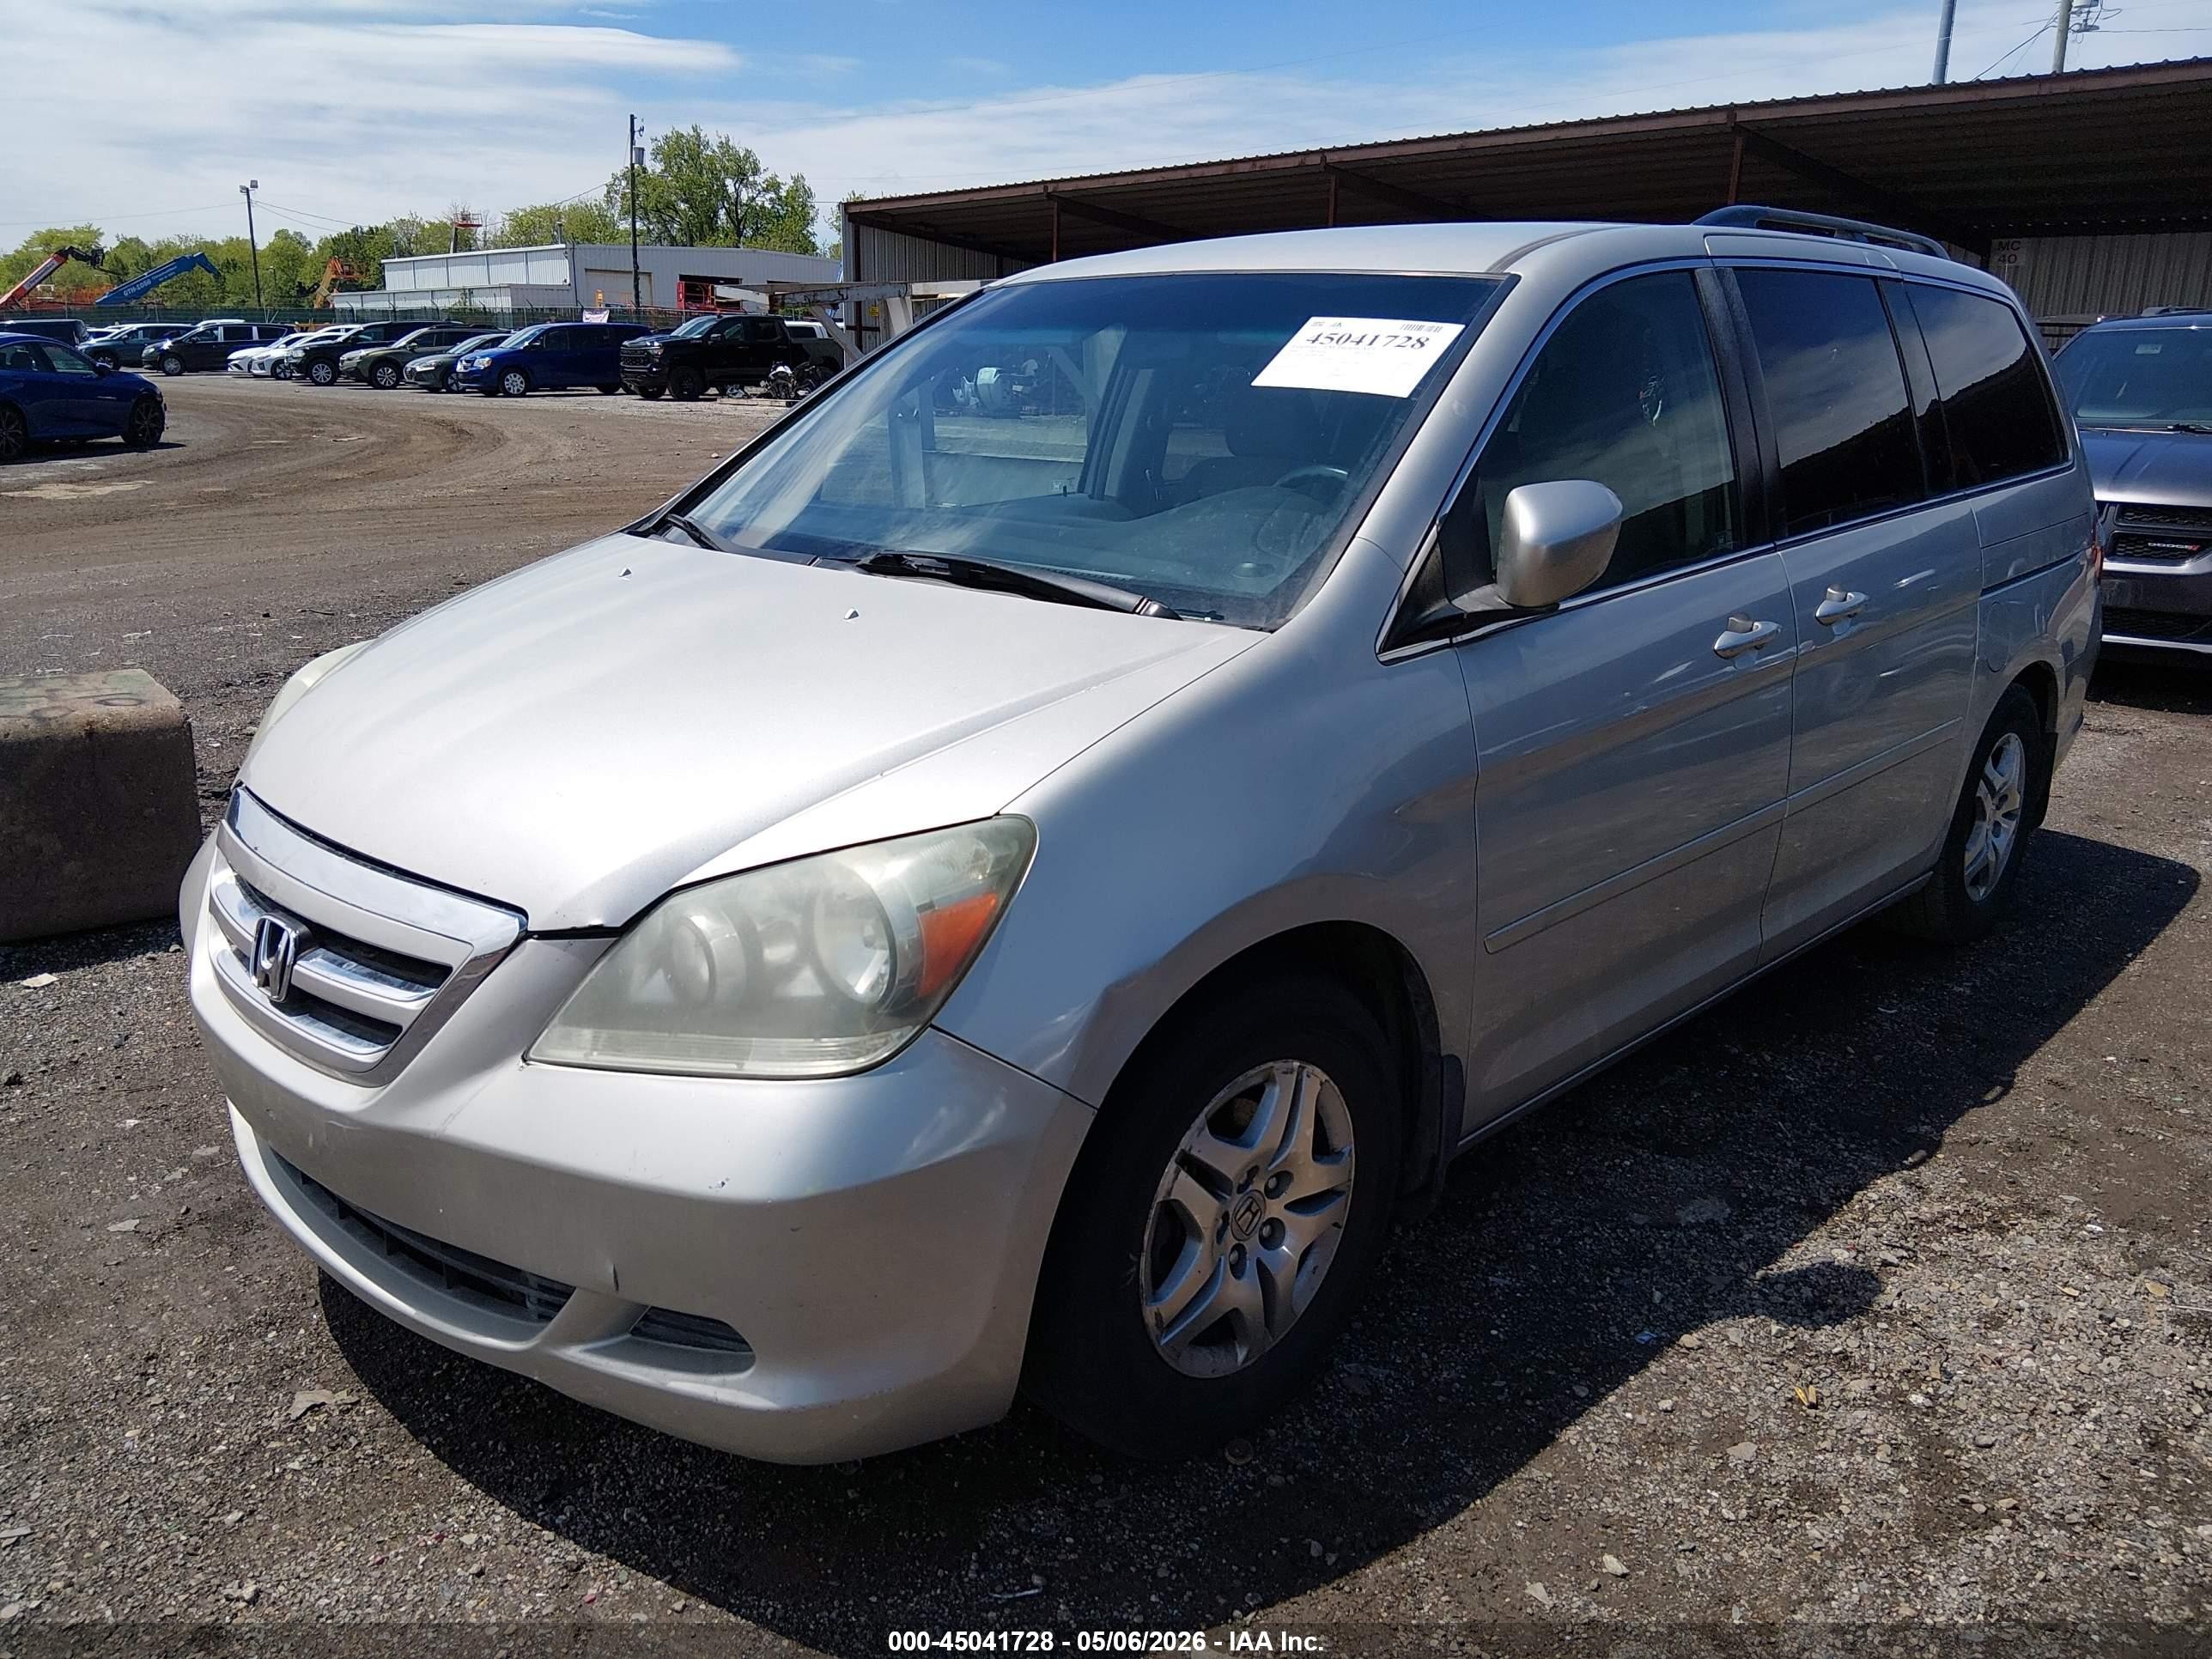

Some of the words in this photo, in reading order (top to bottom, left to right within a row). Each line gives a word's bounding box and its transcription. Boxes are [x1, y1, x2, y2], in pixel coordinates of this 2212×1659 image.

[1997, 240, 2021, 252] MC
[1997, 253, 2018, 264] 40
[1305, 331, 1430, 350] 45041728
